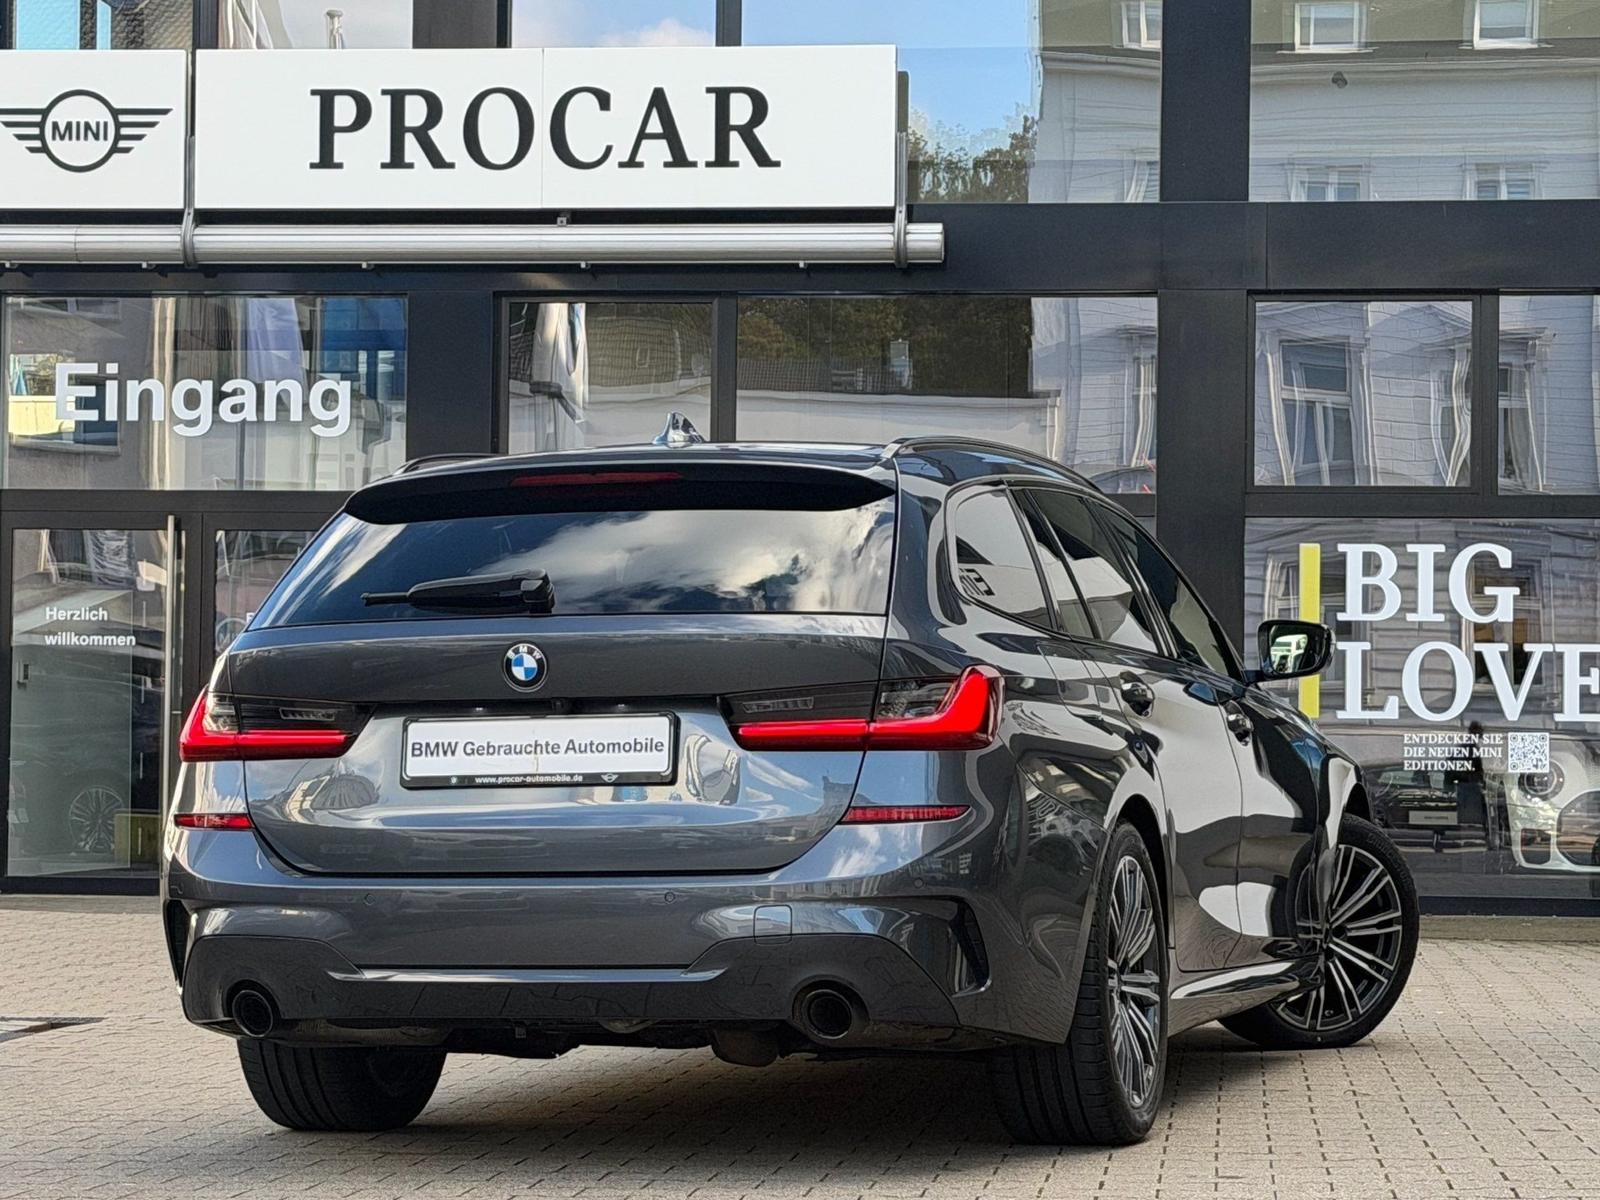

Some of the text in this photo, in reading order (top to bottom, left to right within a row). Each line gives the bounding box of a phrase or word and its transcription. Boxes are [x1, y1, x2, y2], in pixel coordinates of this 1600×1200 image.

[51, 121, 108, 141] MINI
[309, 86, 781, 170] PROCAR
[55, 362, 352, 437] Eingang
[1336, 542, 1520, 623] BIG
[45, 606, 108, 621] Herzlich
[44, 632, 136, 647] willkommen
[1335, 641, 1600, 722] LOVE
[411, 737, 665, 757] BMW Gebrauchte Automobile
[1403, 733, 1503, 744] ENTDECKEN SIE
[1403, 747, 1503, 758] DIE NEUEN MINI
[1403, 760, 1476, 771] EDITIONEN.
[475, 774, 583, 784] www.procar-automobile.de
